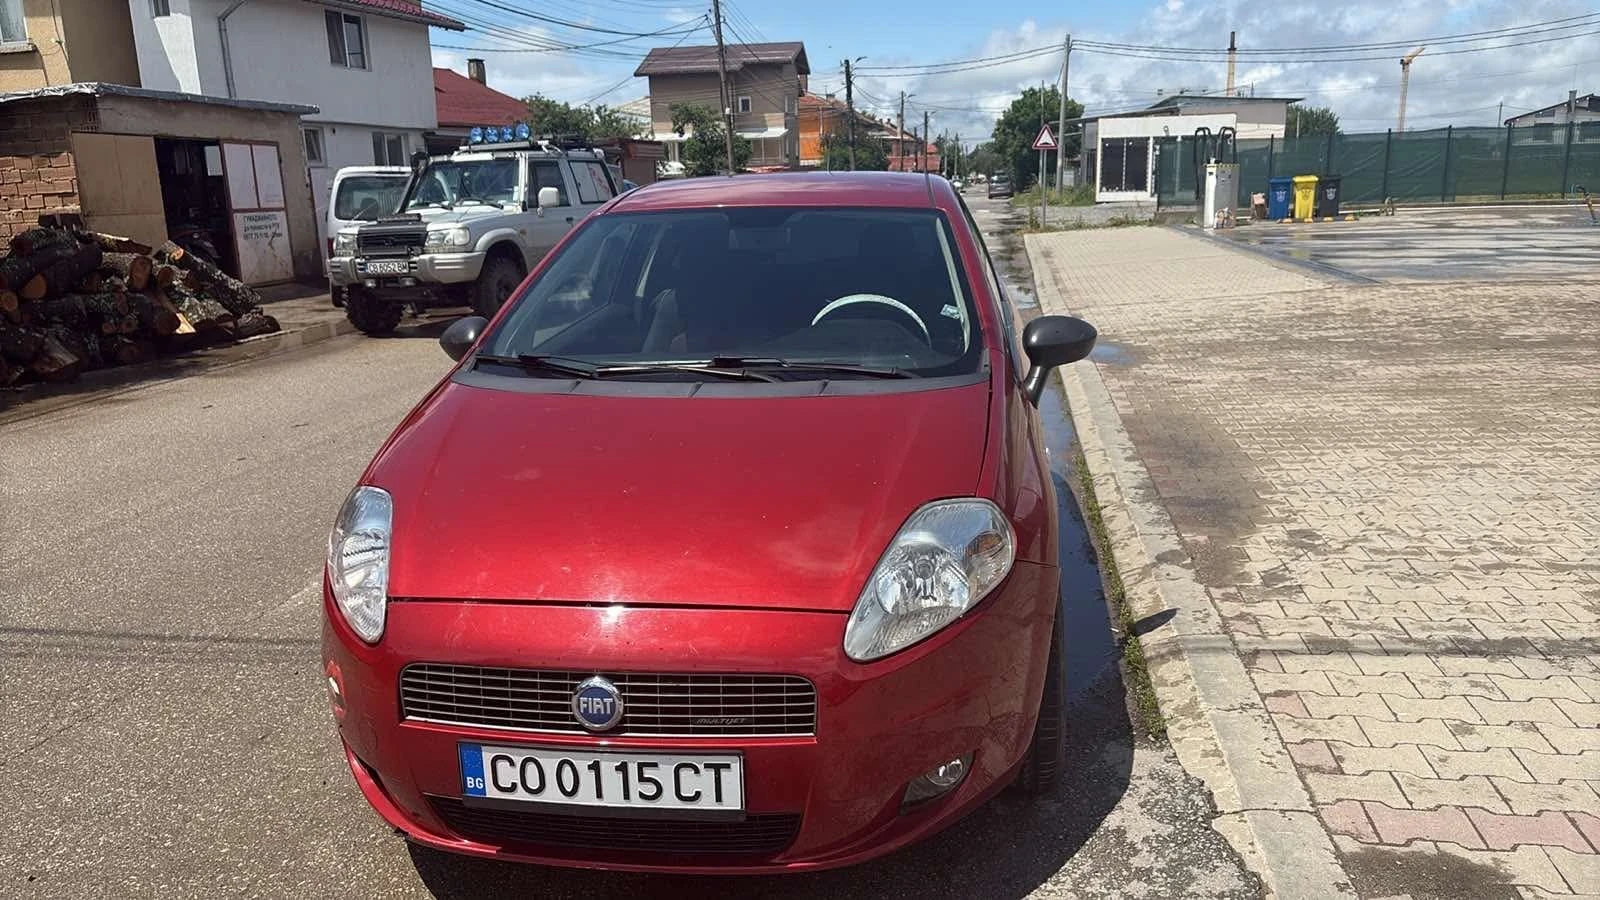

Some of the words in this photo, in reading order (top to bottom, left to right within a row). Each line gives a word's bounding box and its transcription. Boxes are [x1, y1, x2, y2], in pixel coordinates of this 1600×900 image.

[579, 697, 614, 715] FIAT
[466, 776, 484, 789] BG
[490, 754, 546, 795] CO
[555, 758, 664, 801] 0115
[673, 762, 732, 803] CT
